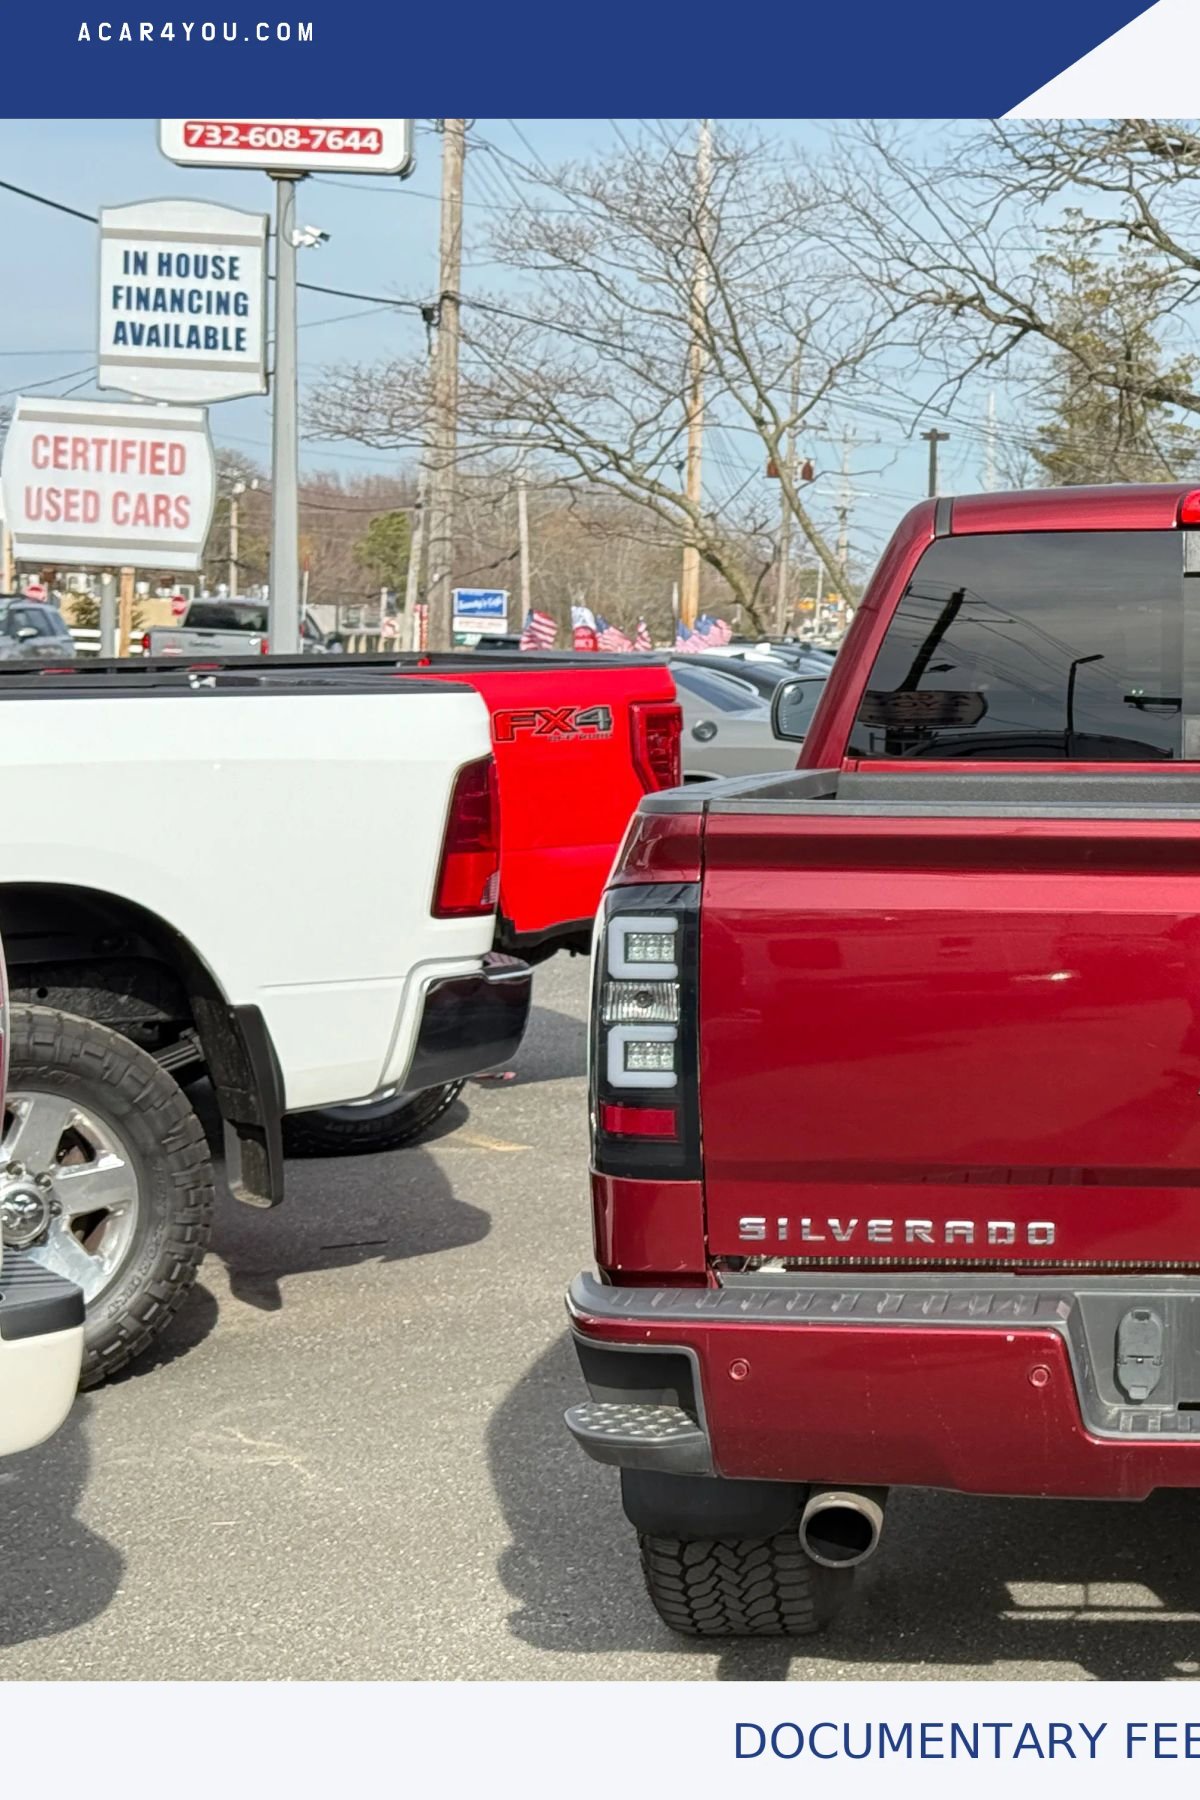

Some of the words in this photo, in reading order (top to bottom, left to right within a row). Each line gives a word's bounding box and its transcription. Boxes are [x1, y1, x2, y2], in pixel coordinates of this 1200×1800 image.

[185, 124, 380, 151] 732-608-7644
[123, 250, 148, 276] IN
[158, 252, 240, 281] HOUSE
[112, 285, 249, 317] FINANCING
[112, 320, 247, 352] AVAILABLE
[31, 434, 187, 476] CERTIFIED
[25, 486, 100, 523] USED
[111, 491, 191, 529] CARS
[493, 706, 613, 742] FX4
[739, 1217, 1056, 1245] SILVERADO
